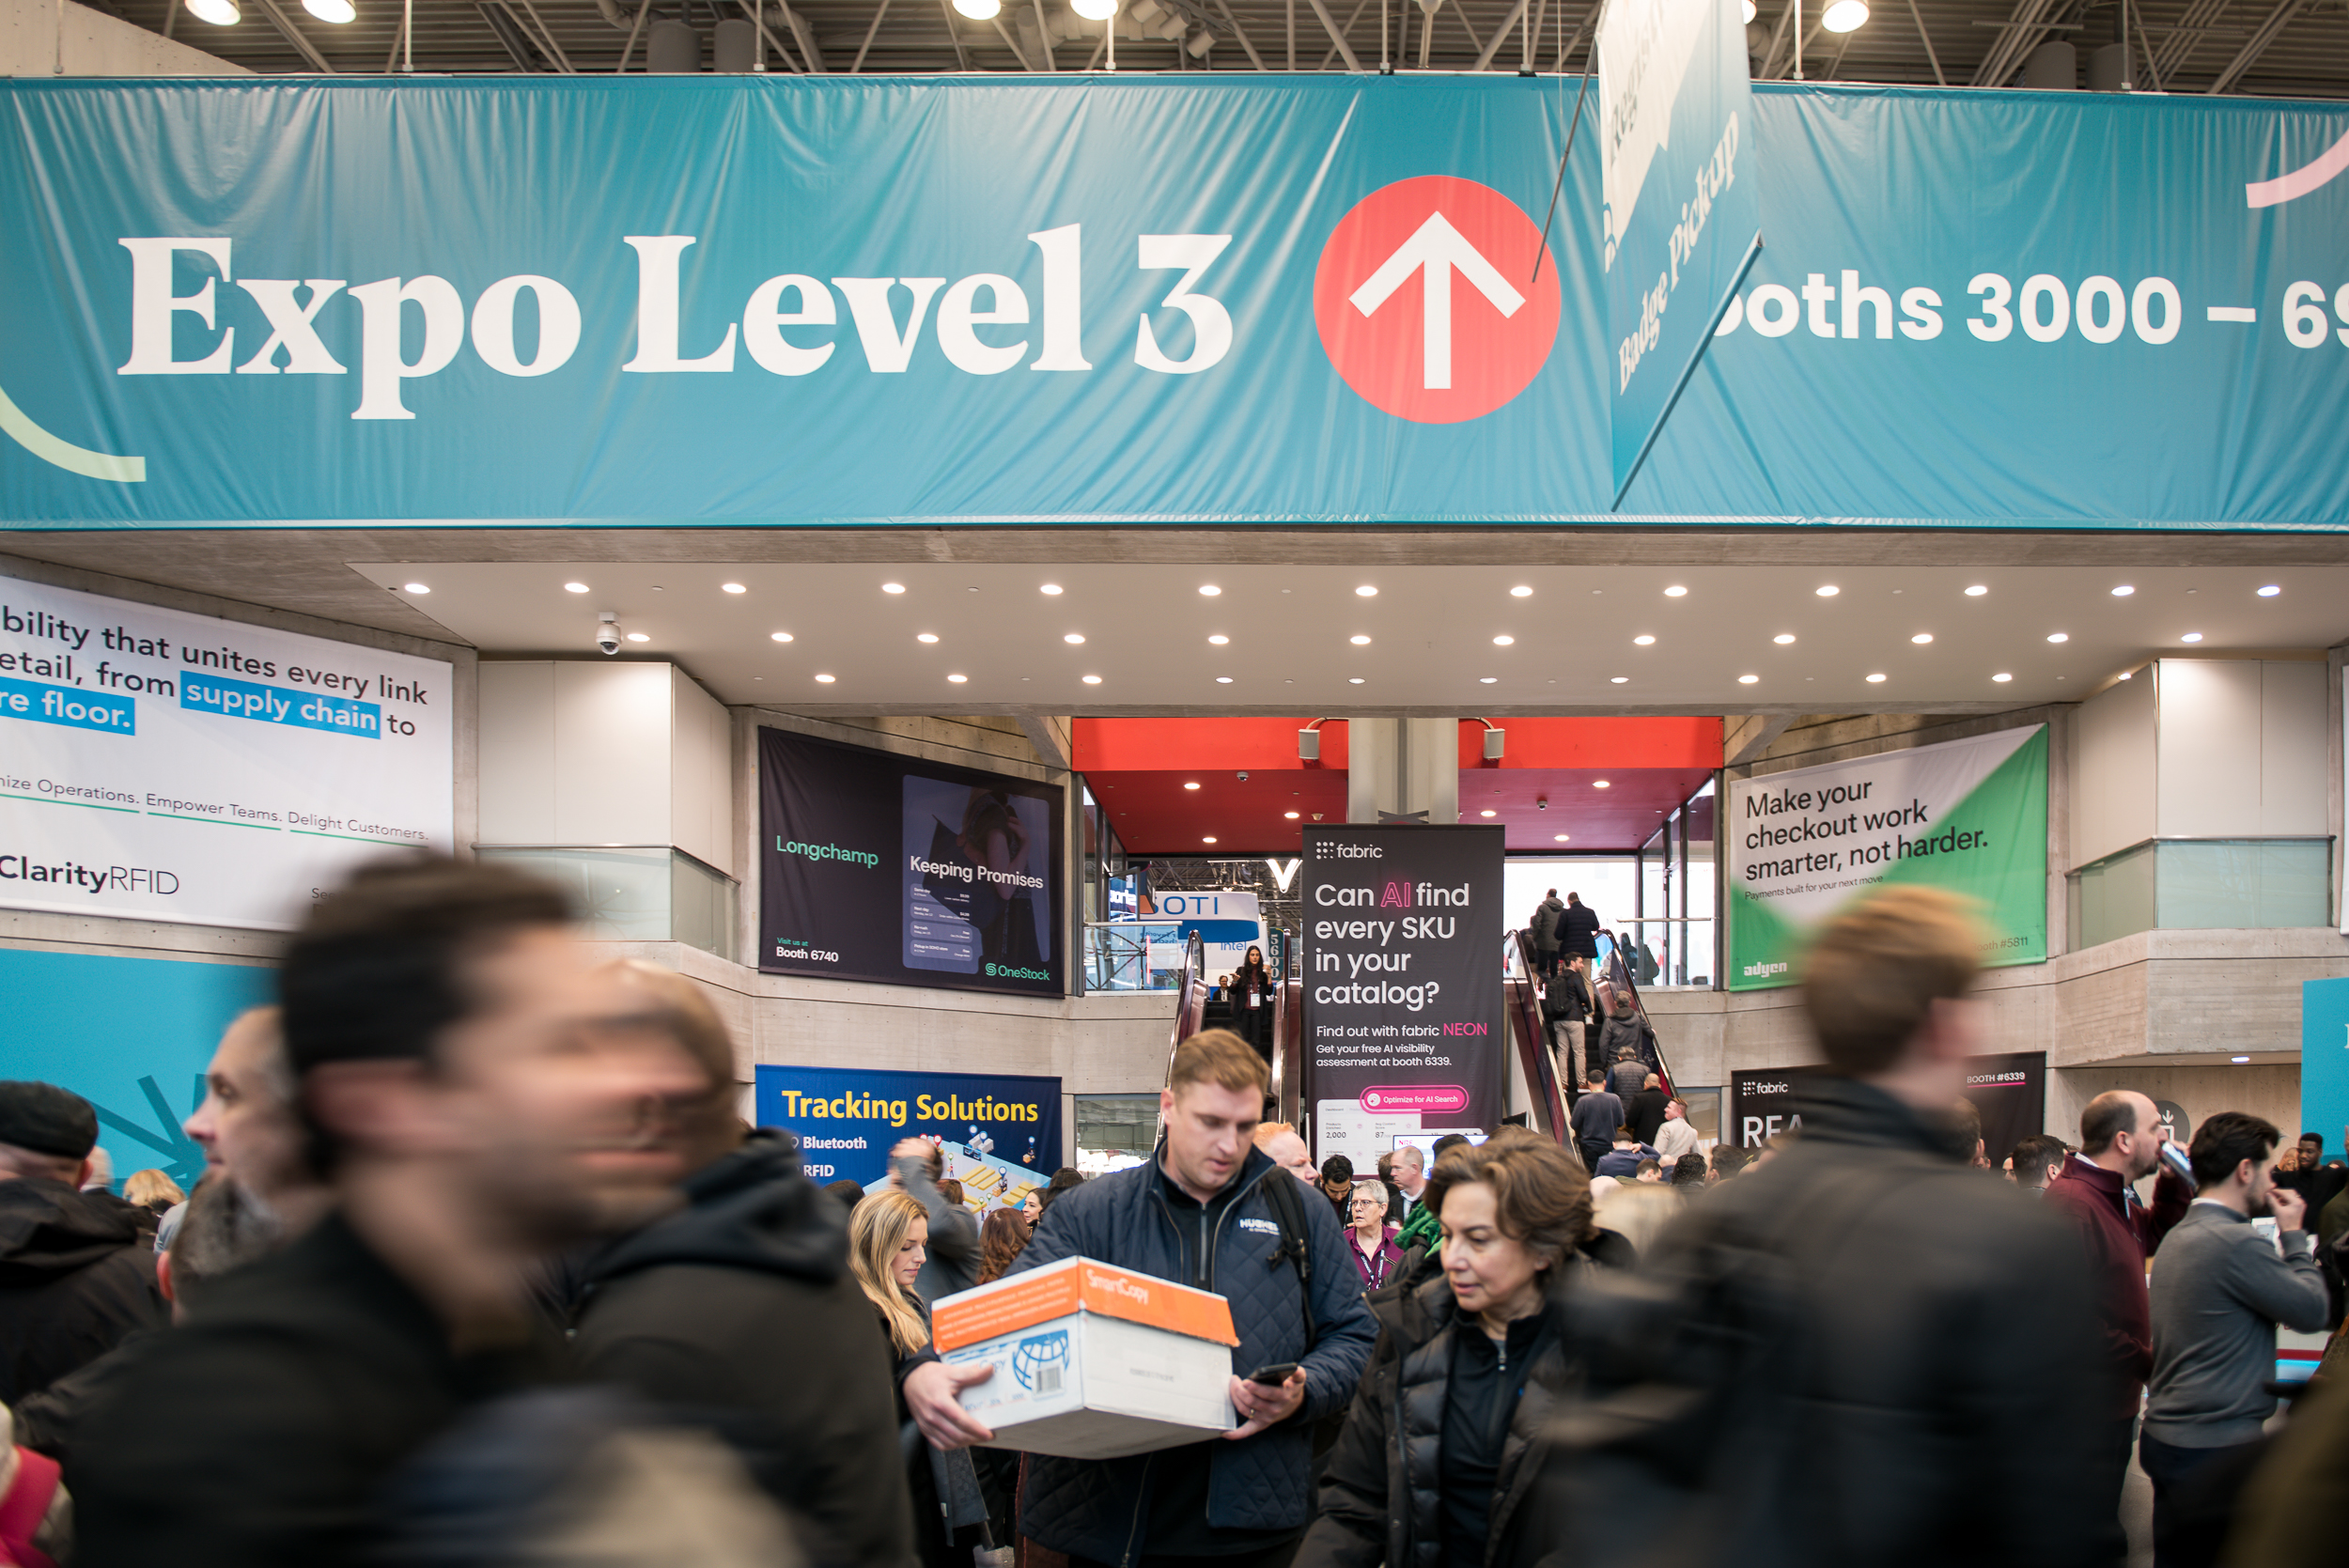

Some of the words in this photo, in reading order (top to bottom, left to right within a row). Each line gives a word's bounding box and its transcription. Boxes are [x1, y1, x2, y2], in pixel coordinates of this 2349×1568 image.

[1618, 272, 1669, 396] Badge
[1669, 111, 1739, 292] Pickup
[117, 236, 583, 420] Expo
[623, 223, 1092, 376] Level
[1134, 234, 1234, 374] 3
[1967, 273, 2182, 345] 3000
[101, 627, 170, 660] that
[182, 644, 277, 678] unites
[288, 666, 369, 700] every
[379, 675, 428, 706] link
[0, 648, 83, 686] etail,
[96, 662, 176, 697] from
[187, 681, 291, 722] supply
[301, 697, 378, 732] chain
[387, 715, 415, 737] to
[41, 690, 132, 728] floor.
[38, 779, 140, 805] Operations.
[146, 793, 224, 818] Empower
[229, 803, 282, 823] Teams.
[288, 812, 343, 832] Delight
[347, 819, 429, 842] Customers.
[1747, 788, 1811, 818] Make
[1817, 781, 1873, 810] your
[1746, 814, 1858, 849] checkout
[1864, 799, 1928, 831] work
[776, 835, 879, 868] Longchamp
[1337, 844, 1382, 859] fabric
[1746, 850, 1842, 881] smarter,
[1849, 840, 1890, 866] not
[1897, 826, 1988, 860] harder.
[0, 855, 179, 895] ClarityRFID
[910, 855, 973, 883] Keeping
[977, 865, 1043, 889] Promises
[1315, 883, 1374, 907] Can
[1380, 882, 1411, 908] AI
[1416, 882, 1470, 907] find
[1745, 887, 1784, 900] Payments
[1786, 883, 1804, 895] built
[1805, 881, 1816, 893] for
[1818, 880, 1837, 893] your
[1838, 877, 1858, 889] next
[1859, 875, 1883, 885] move
[777, 938, 790, 946] Visit
[1315, 921, 1394, 946] every
[1402, 916, 1455, 939] SKU
[2000, 937, 2028, 948] #5811
[776, 946, 808, 959] Booth
[810, 949, 838, 962] 6740
[1315, 948, 1340, 971] in
[1347, 953, 1410, 978] your
[998, 963, 1050, 981] OneStock
[1744, 961, 1787, 978] adyen
[1315, 981, 1439, 1011] catalog?
[1316, 1025, 1344, 1037] Find
[1346, 1027, 1368, 1037] out
[1371, 1024, 1398, 1036] with
[1401, 1024, 1439, 1036] fabric
[1443, 1023, 1487, 1036] NEON
[1316, 1045, 1333, 1054] Get
[1336, 1046, 1359, 1056] your
[1361, 1044, 1381, 1054] free
[1383, 1045, 1392, 1053] AI
[1395, 1044, 1435, 1056] visibility
[1316, 1057, 1377, 1067] assessment
[1379, 1058, 1390, 1067] at
[1392, 1057, 1422, 1066] booth
[1424, 1057, 1452, 1066] 6339.
[1757, 1082, 1788, 1094] fabric
[1967, 1073, 1995, 1084] BOOTH
[1997, 1071, 2025, 1082] #6339
[782, 1091, 907, 1126] Tracking
[916, 1094, 1038, 1122] Solutions
[1383, 1094, 1412, 1105] Optimize
[1414, 1094, 1424, 1103] for
[1434, 1094, 1457, 1103] Search
[802, 1136, 866, 1150] Bluetooth
[803, 1164, 834, 1177] RFID
[1087, 1269, 1149, 1305] SmartCopy
